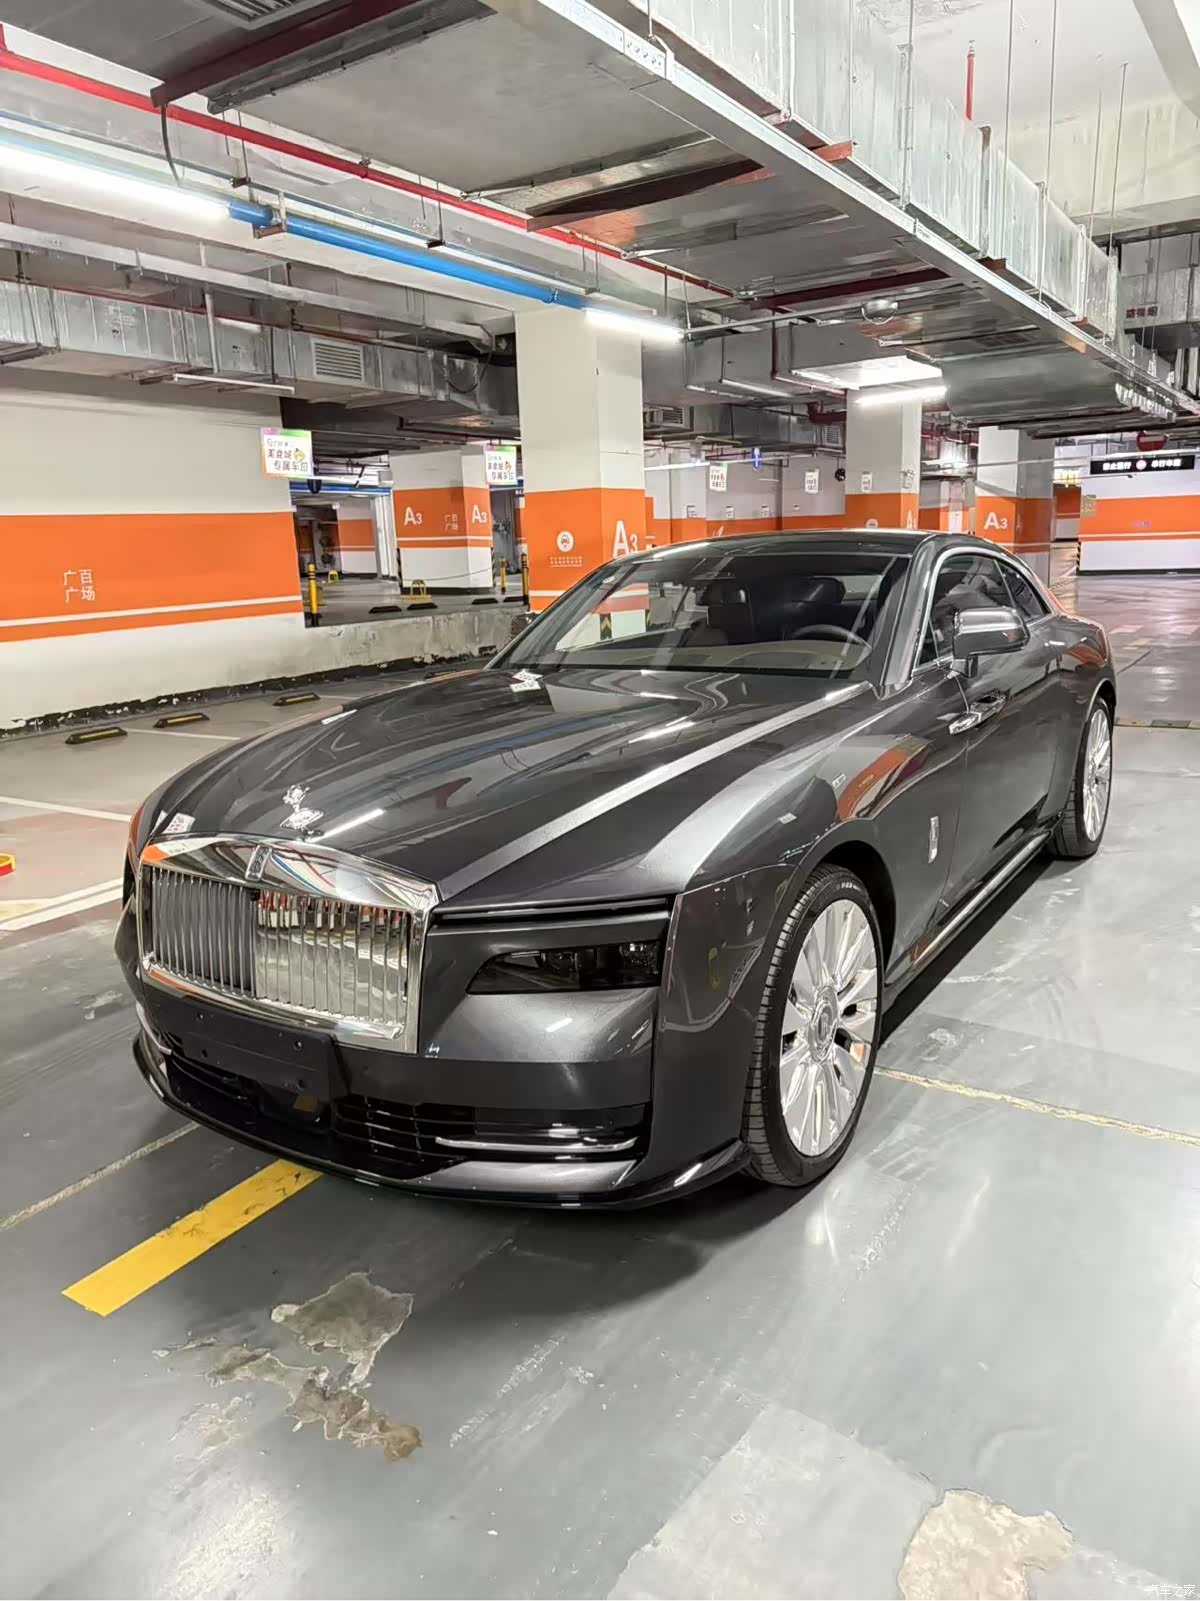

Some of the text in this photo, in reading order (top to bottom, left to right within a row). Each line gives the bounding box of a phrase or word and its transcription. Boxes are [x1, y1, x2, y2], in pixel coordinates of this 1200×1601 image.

[404, 505, 423, 526] A3
[471, 503, 488, 524] A3
[983, 511, 1009, 530] A3
[612, 519, 639, 558] A3
[63, 569, 93, 587] 广百
[64, 586, 96, 604] 广场
